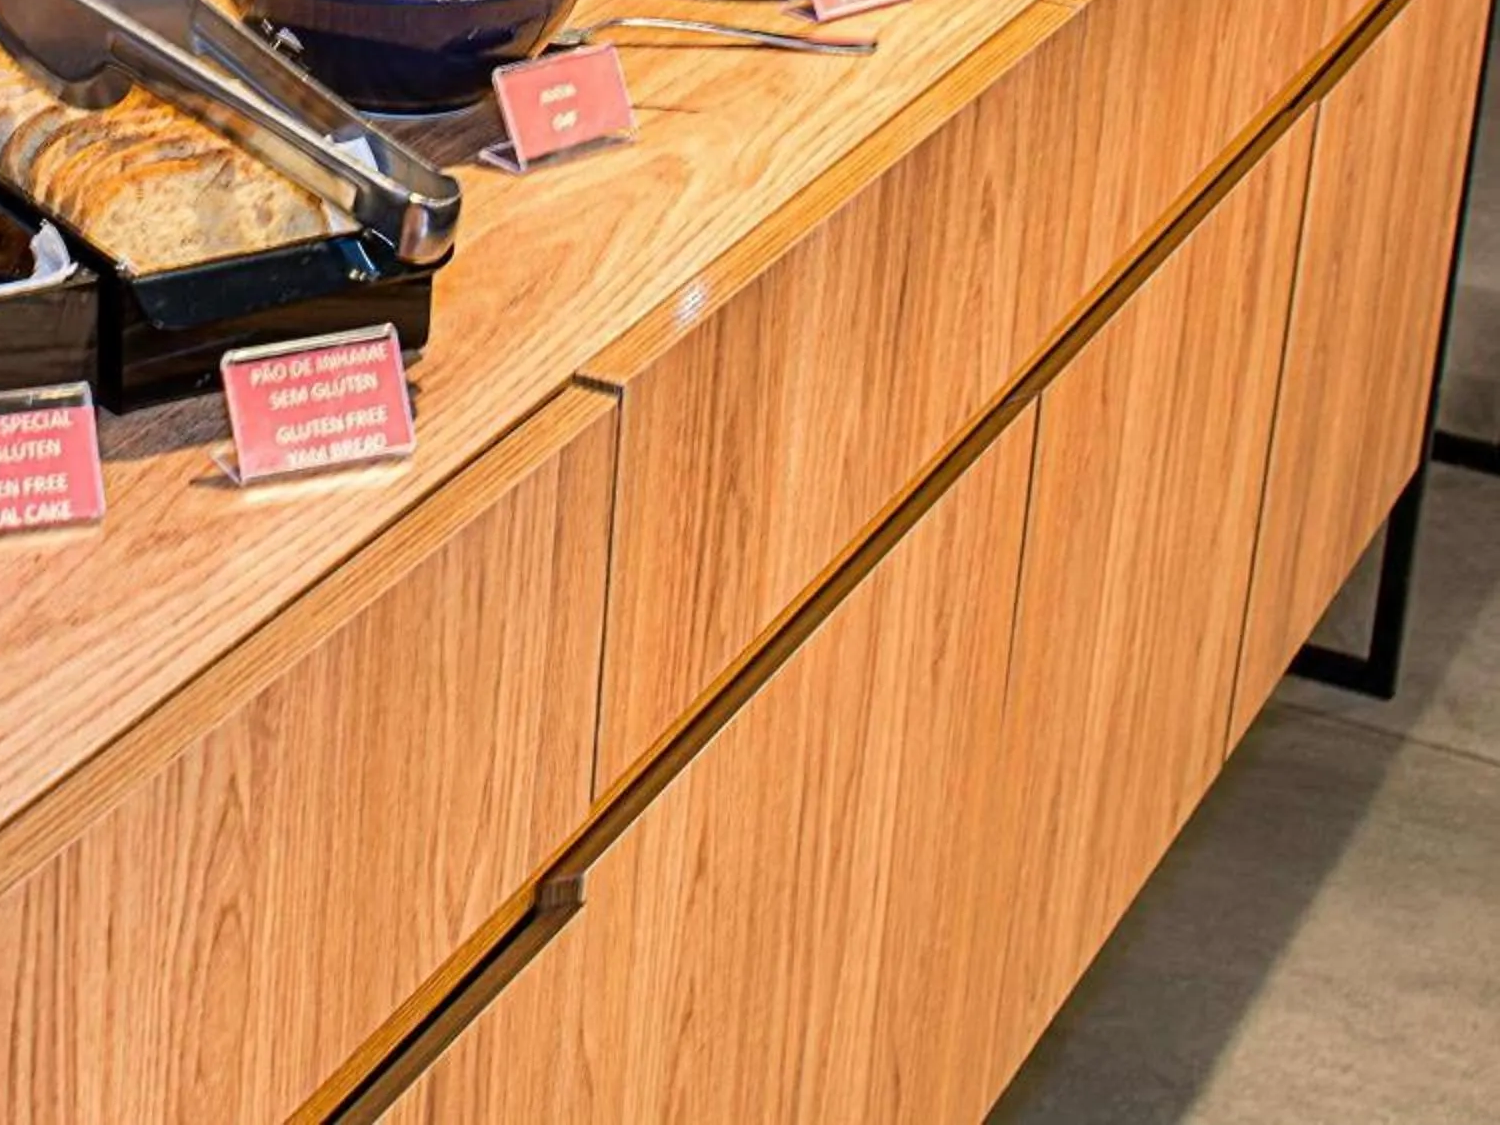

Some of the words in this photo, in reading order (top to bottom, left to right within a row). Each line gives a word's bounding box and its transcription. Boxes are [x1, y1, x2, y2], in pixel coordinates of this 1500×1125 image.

[289, 359, 314, 378] DE
[269, 387, 309, 410] SEM
[275, 415, 345, 444] GLUTEN
[346, 404, 388, 429] FREE
[22, 472, 69, 494] FREE
[24, 500, 74, 524] CAKE
